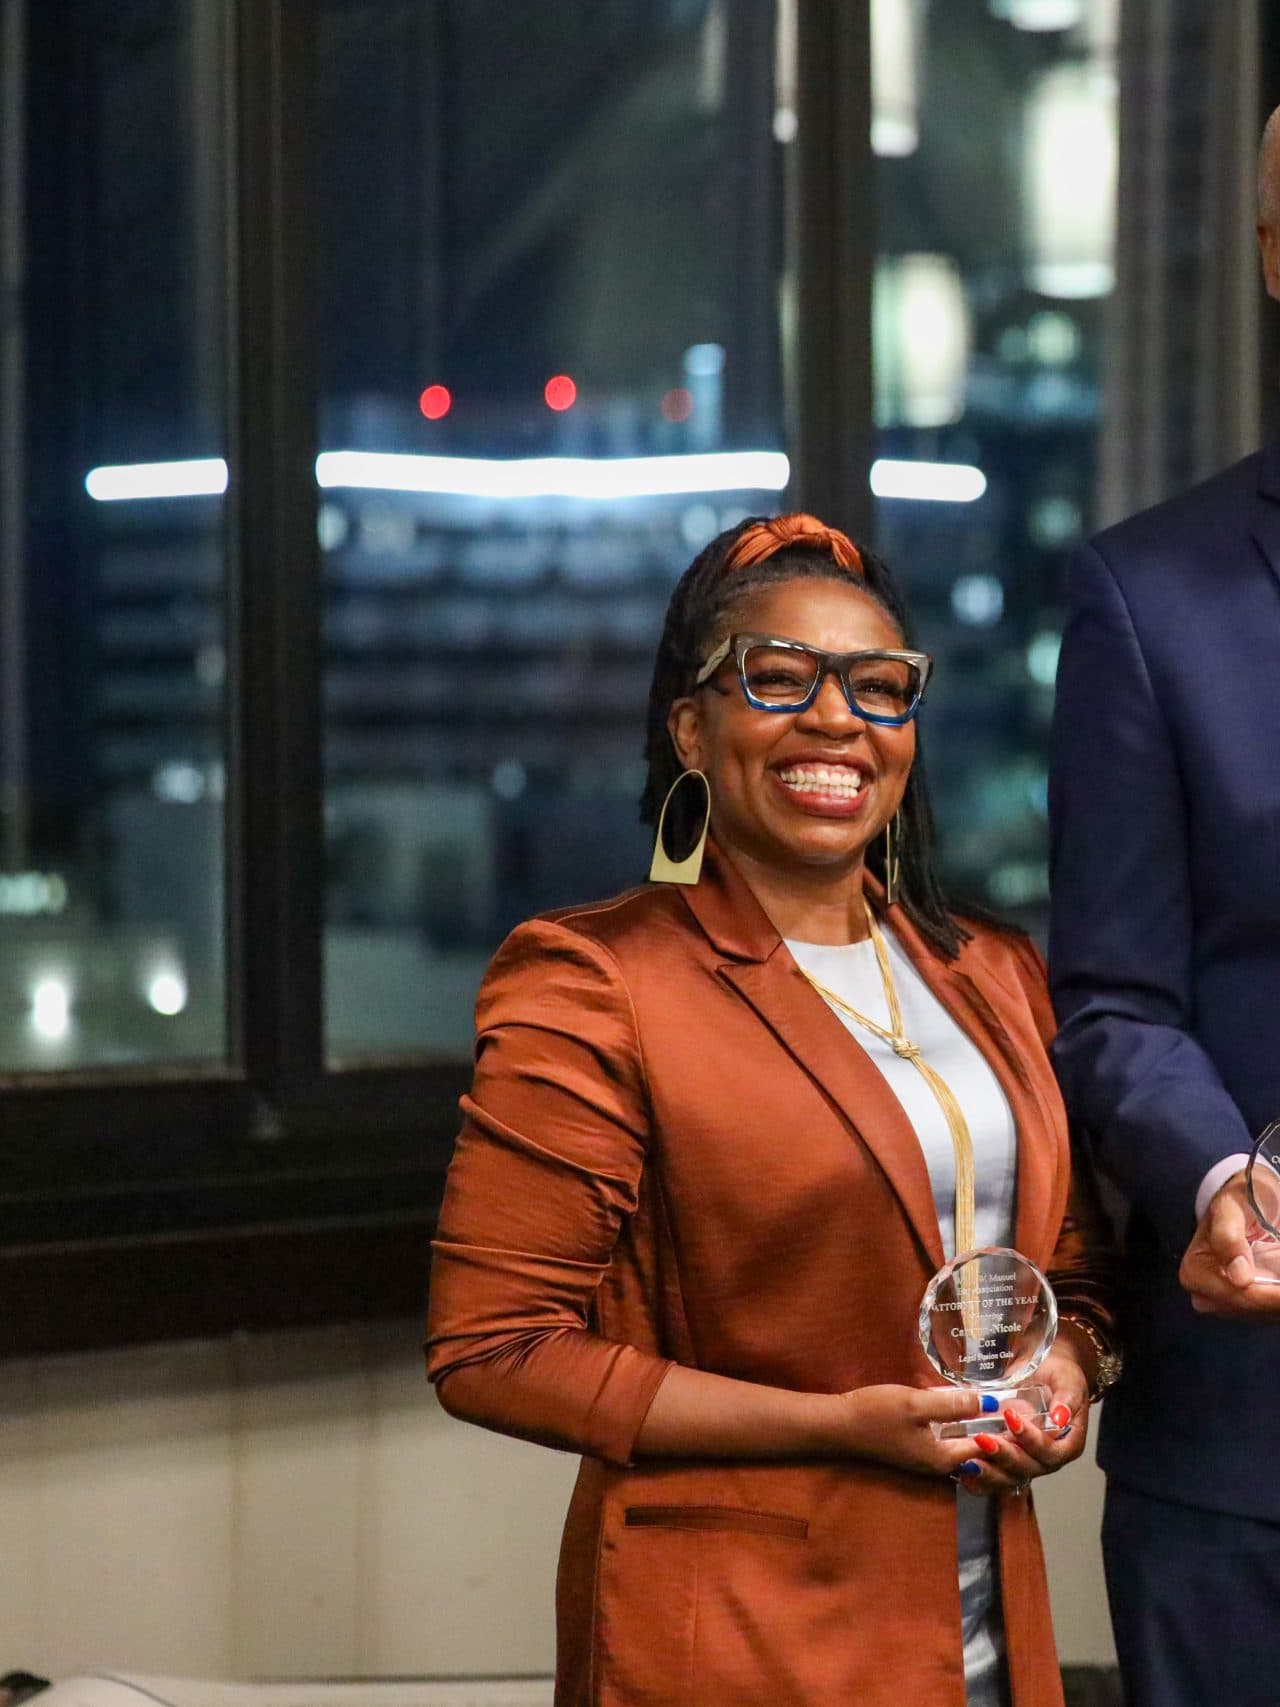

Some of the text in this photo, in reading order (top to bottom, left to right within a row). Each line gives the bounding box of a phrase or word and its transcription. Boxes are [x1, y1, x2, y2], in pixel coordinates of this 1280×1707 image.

[989, 1272, 1016, 1282] Manuel
[982, 1299, 993, 1308] OF
[994, 1297, 1013, 1306] THE
[1015, 1295, 1039, 1305] YEAR
[951, 1322, 1022, 1338] Can-Nicole
[979, 1337, 997, 1348] Cox
[959, 1351, 1014, 1363] Legal Fusion Gala
[979, 1361, 995, 1370] 2025
